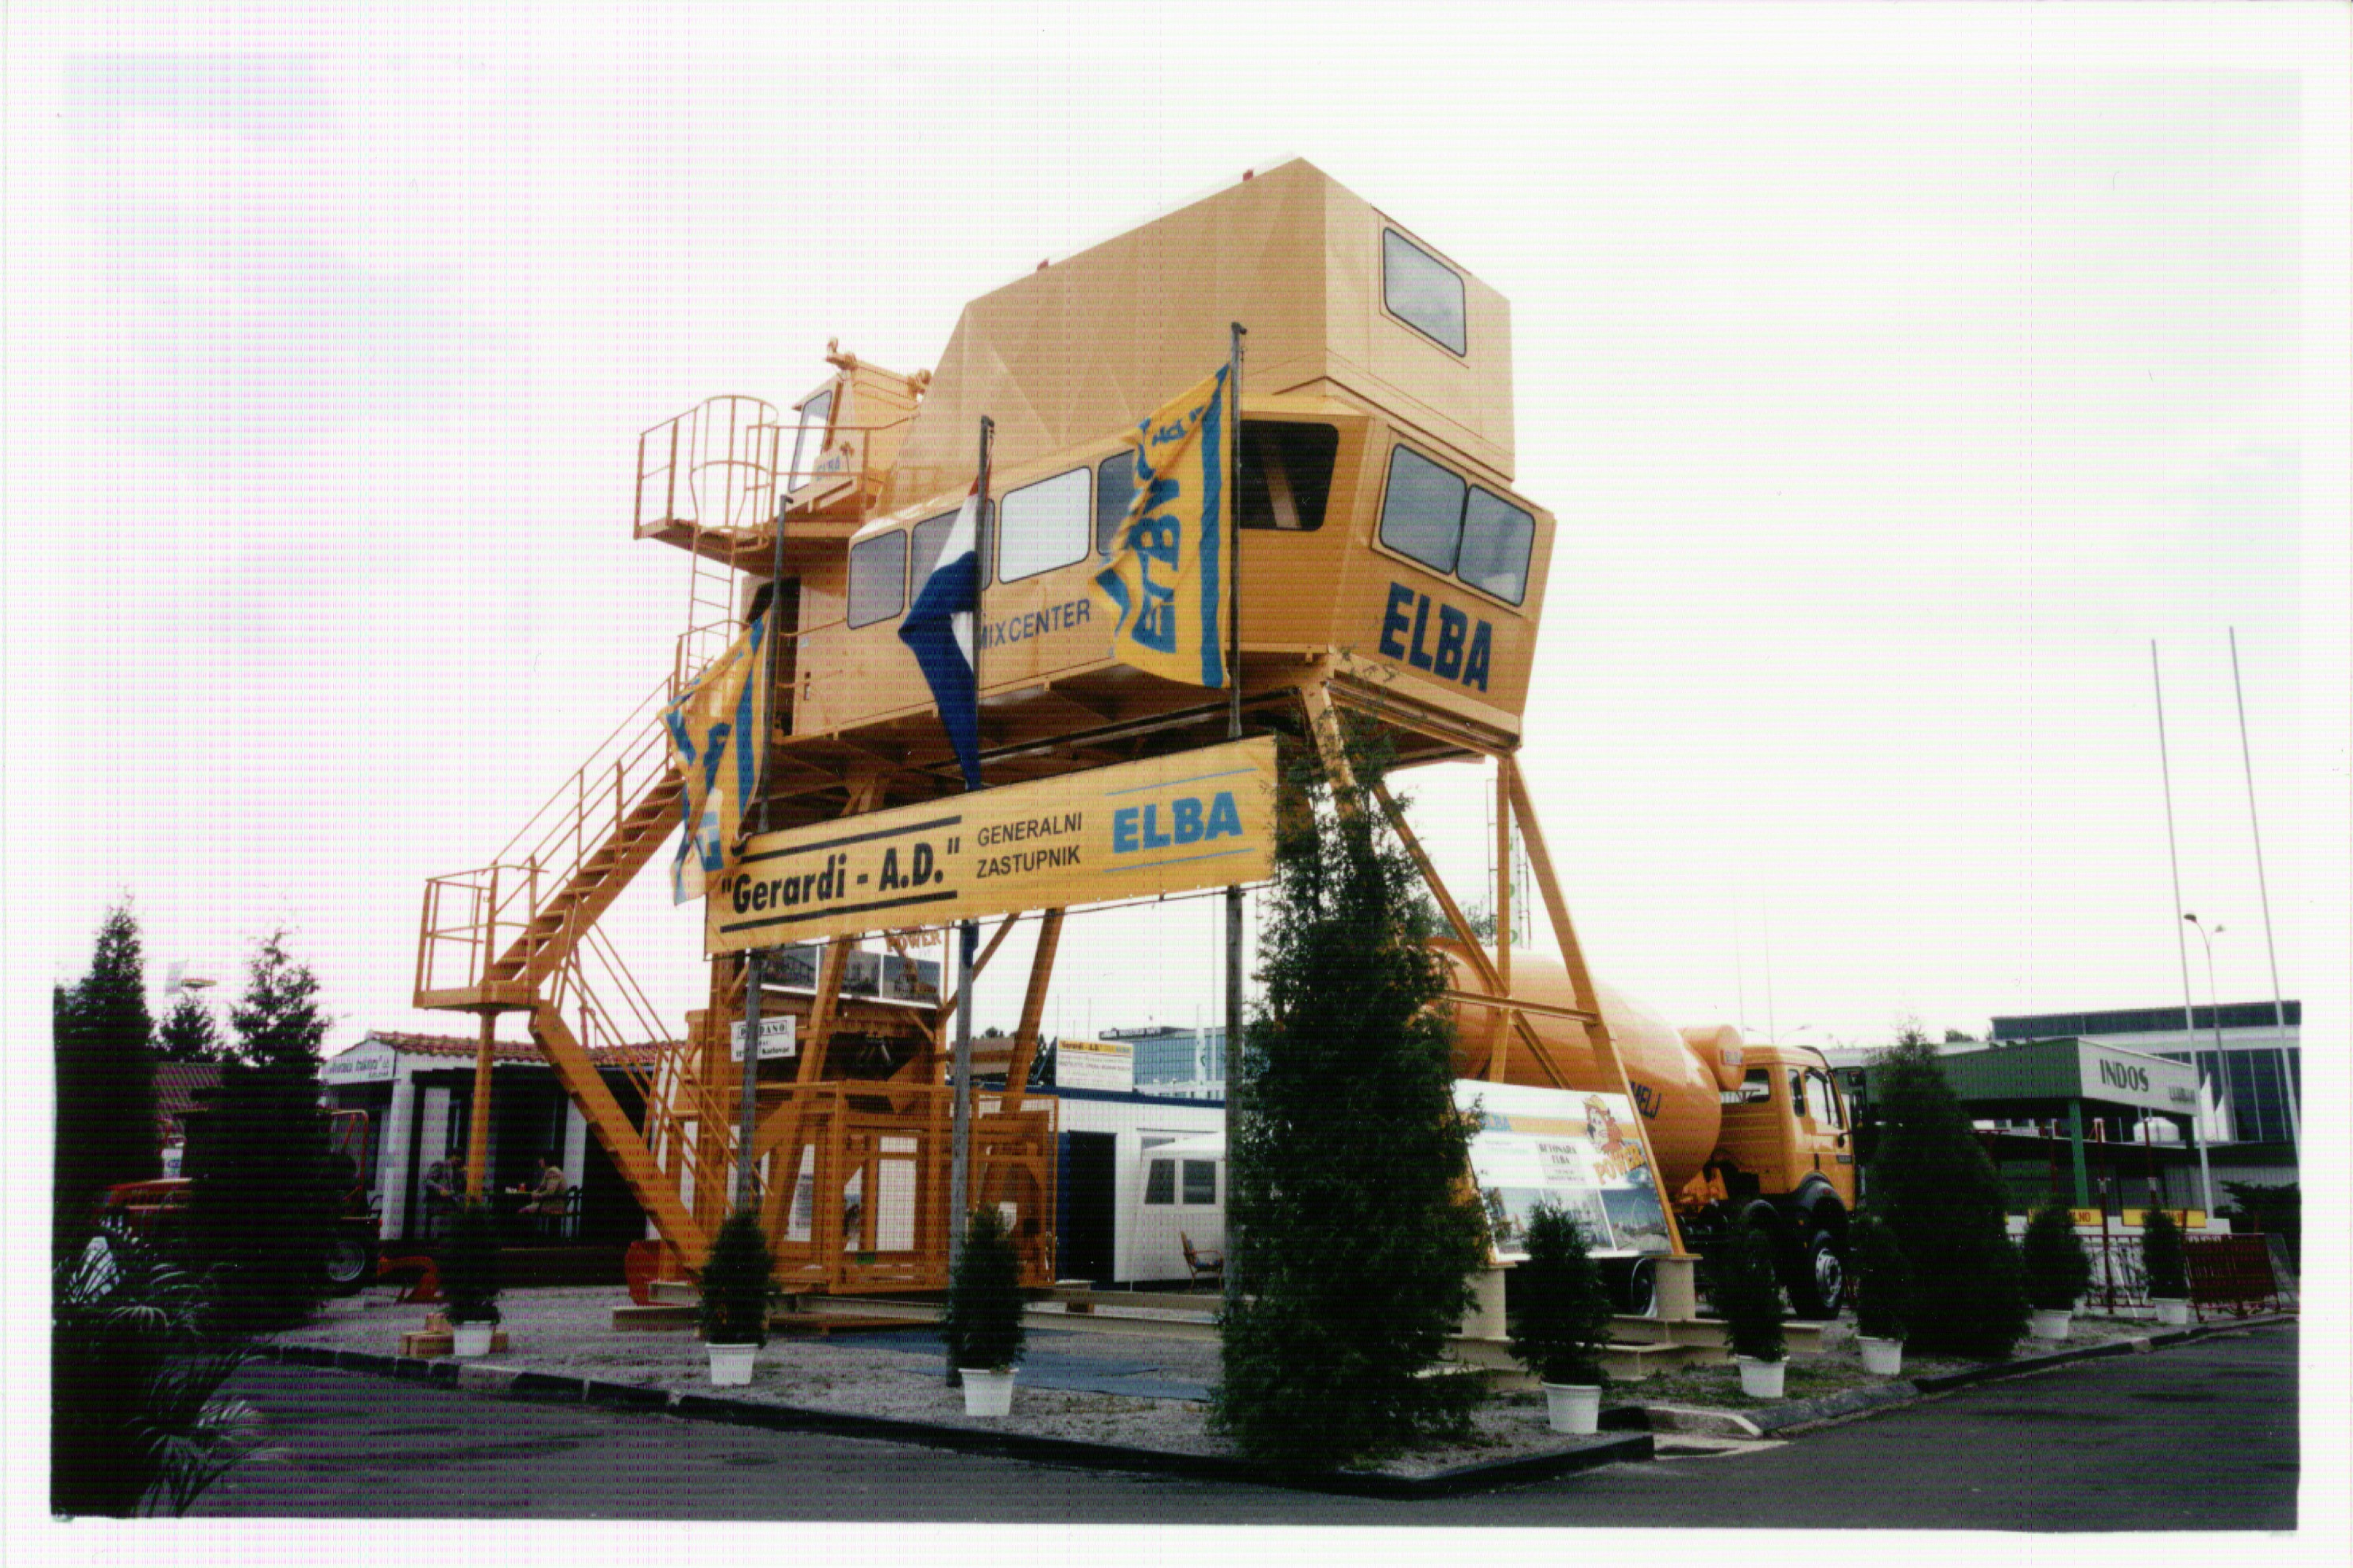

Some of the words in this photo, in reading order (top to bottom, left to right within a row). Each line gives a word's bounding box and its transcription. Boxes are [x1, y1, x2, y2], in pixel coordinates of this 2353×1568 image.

[1378, 581, 1492, 693] ELBA
[977, 811, 1082, 848] GENERALNI
[1113, 791, 1244, 854] ELBA
[721, 853, 847, 914] "Gerardi
[879, 837, 959, 892] A.D."
[977, 845, 1081, 879] ZASTUPNIK
[886, 931, 941, 953] POWER
[740, 1023, 785, 1036] PDANO
[2099, 1058, 2149, 1093] INDOS
[1477, 1113, 1512, 1132] LBA
[1593, 1142, 1646, 1187] POWER
